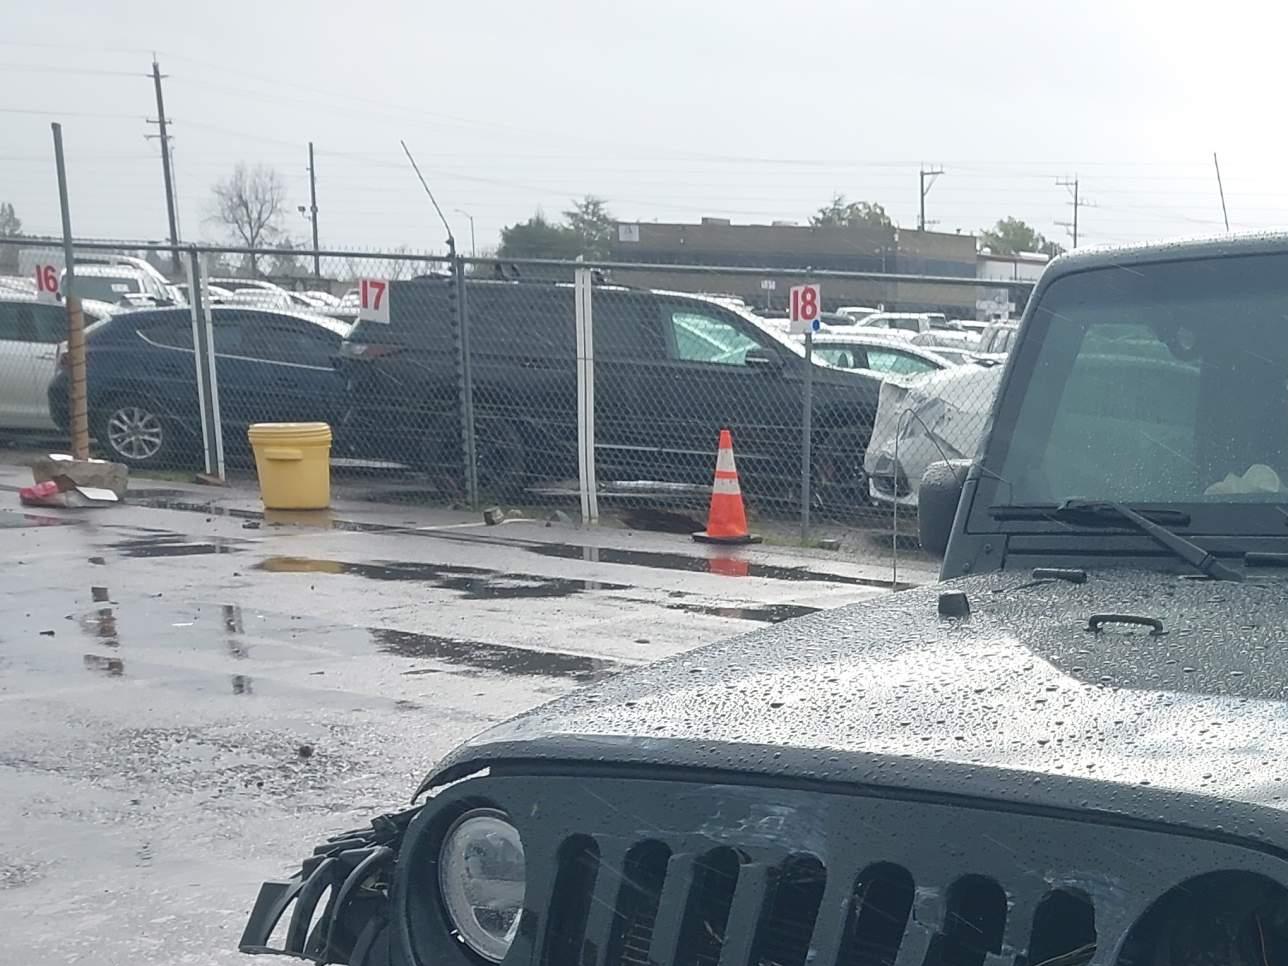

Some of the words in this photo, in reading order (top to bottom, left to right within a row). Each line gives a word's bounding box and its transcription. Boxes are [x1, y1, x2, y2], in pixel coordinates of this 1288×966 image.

[36, 264, 58, 292] 16
[361, 279, 386, 311] 17
[793, 287, 817, 321] 18
